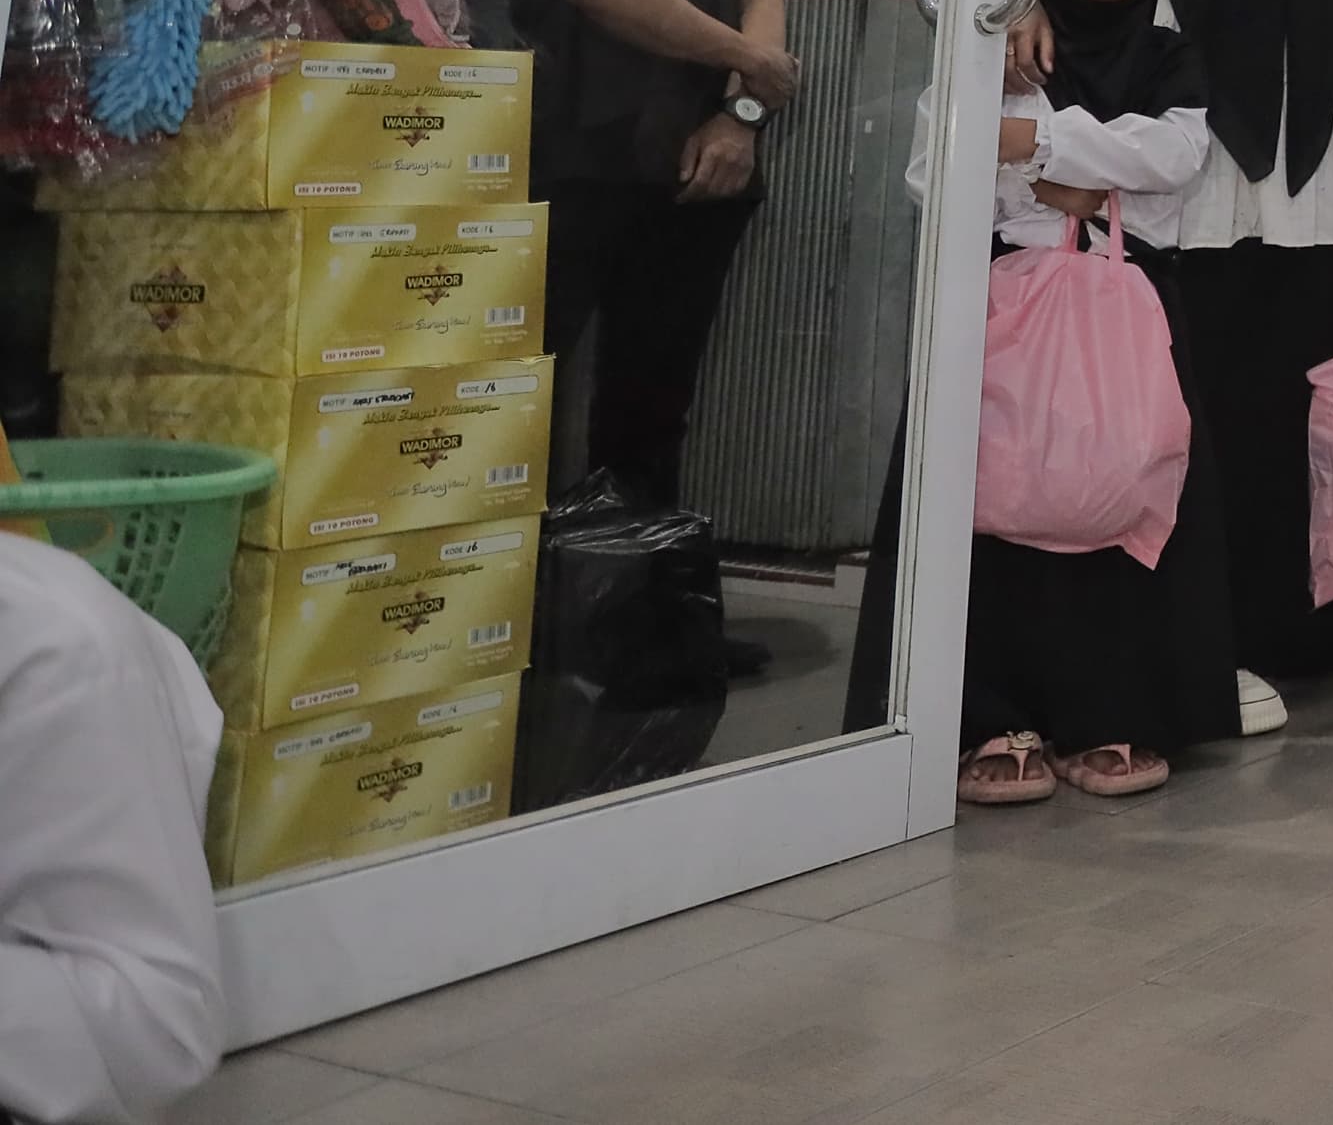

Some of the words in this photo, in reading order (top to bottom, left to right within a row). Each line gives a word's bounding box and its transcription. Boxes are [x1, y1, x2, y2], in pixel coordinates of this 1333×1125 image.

[304, 64, 329, 75] MOTIF
[444, 70, 462, 79] KODE
[385, 117, 442, 129] WADIMOR
[324, 185, 357, 193] POTONG
[332, 229, 354, 239] MOTIF
[461, 227, 478, 235] KODE
[407, 274, 461, 289] WADIMOR
[132, 285, 202, 303] WADIMOR
[350, 348, 381, 359] POTONG
[461, 385, 480, 395] KODE
[322, 397, 346, 409] MOTIF
[402, 436, 460, 454] WADIMOR
[340, 517, 374, 529] POTONG
[384, 599, 443, 621] WADIMOR
[359, 763, 422, 790] WADIMOR
